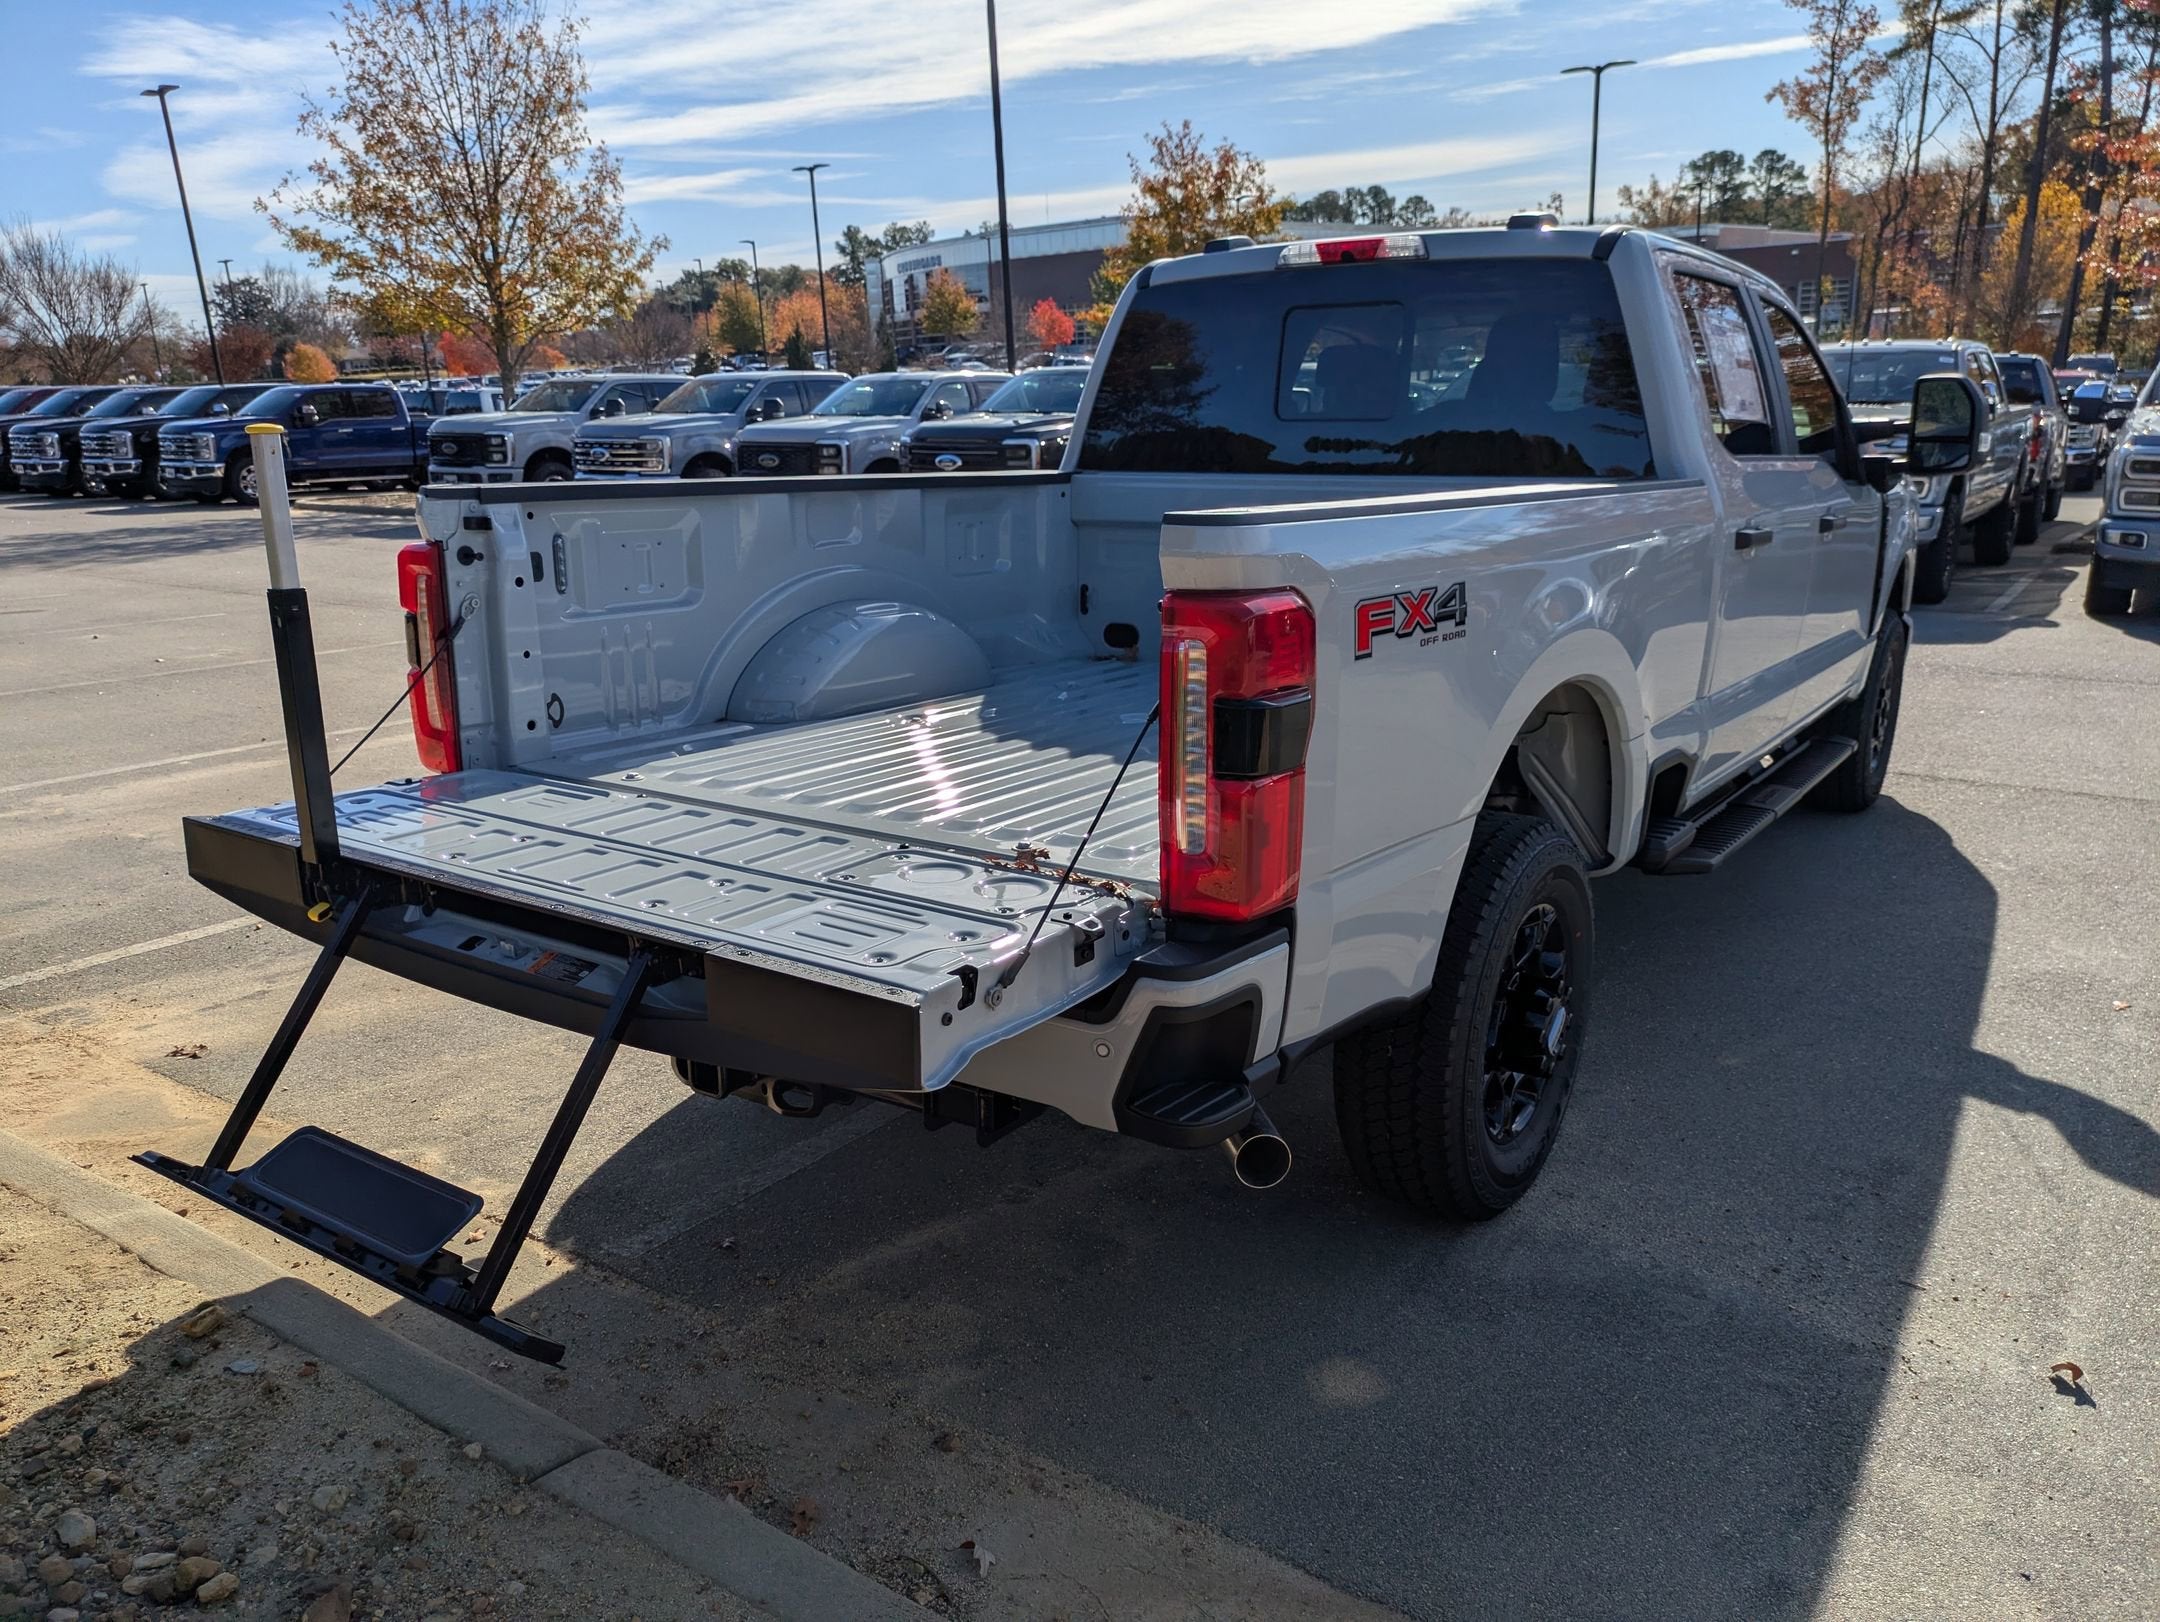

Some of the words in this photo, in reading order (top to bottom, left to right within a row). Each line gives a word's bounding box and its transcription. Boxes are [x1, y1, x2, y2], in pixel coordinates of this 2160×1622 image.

[1354, 581, 1467, 661] FX4
[1420, 635, 1439, 647] OFF
[1442, 629, 1466, 642] ROAD
